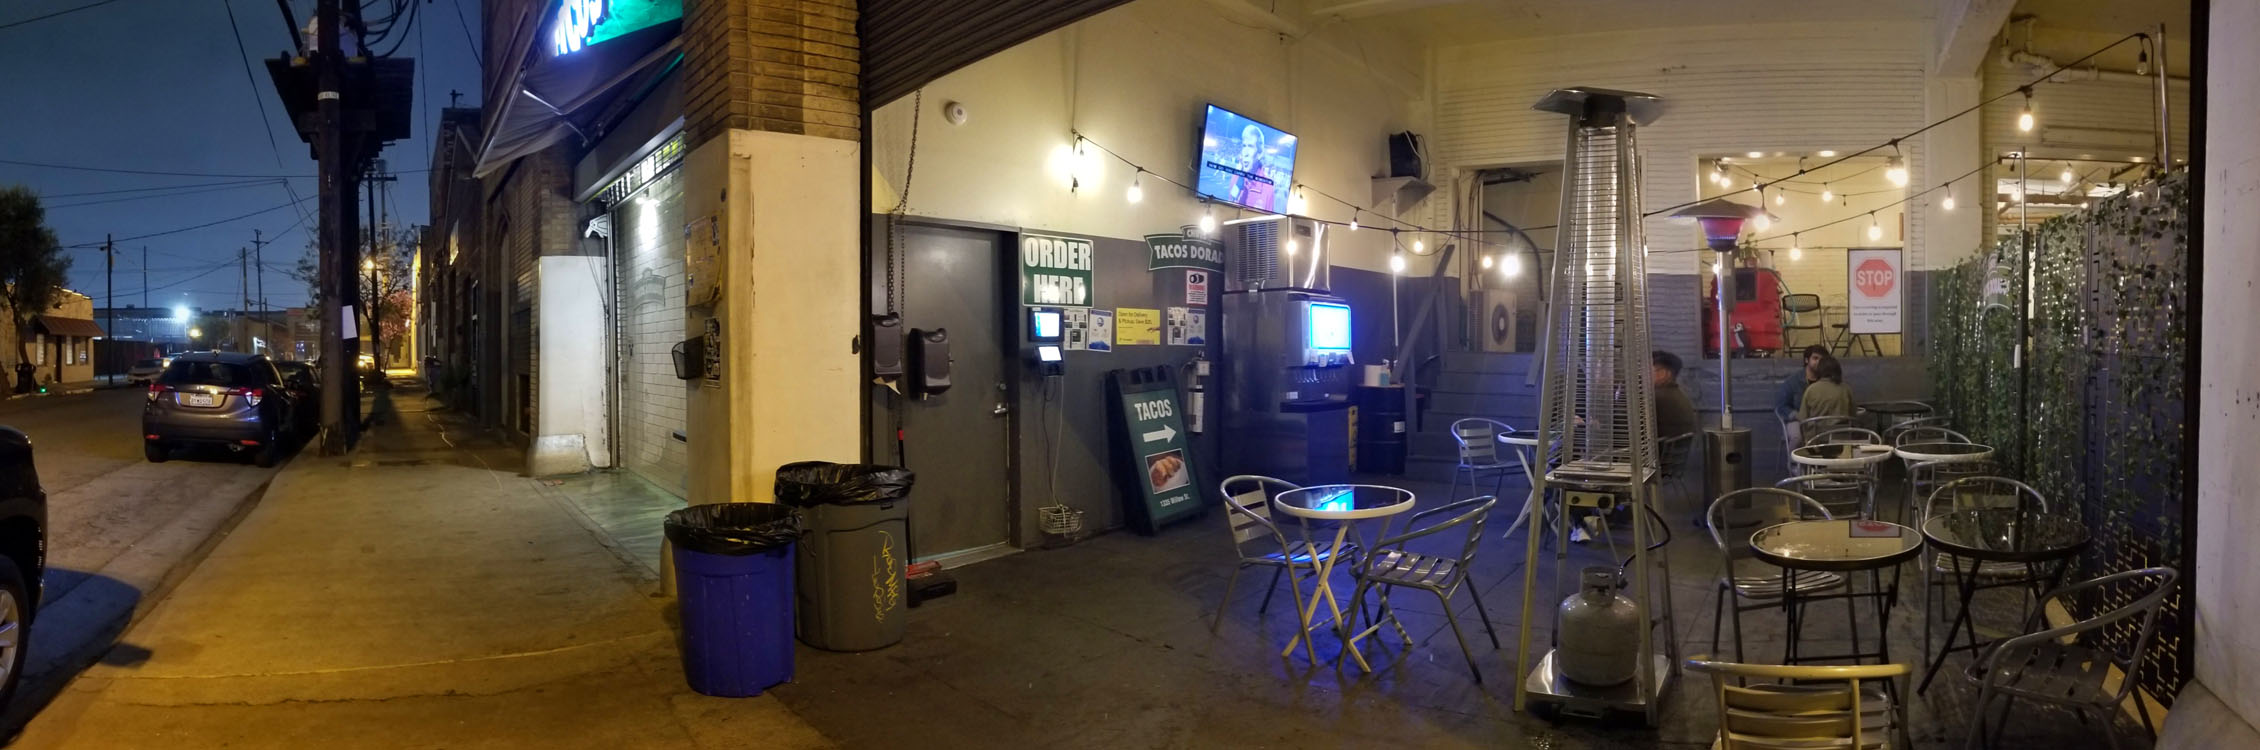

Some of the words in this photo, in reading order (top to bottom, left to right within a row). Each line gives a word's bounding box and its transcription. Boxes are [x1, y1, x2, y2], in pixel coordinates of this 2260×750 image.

[1024, 237, 1091, 271] ORDER
[1154, 244, 1188, 259] TACOS
[1857, 269, 1893, 286] STOP
[1033, 274, 1085, 305] HERE
[1134, 399, 1172, 421] TACOS
